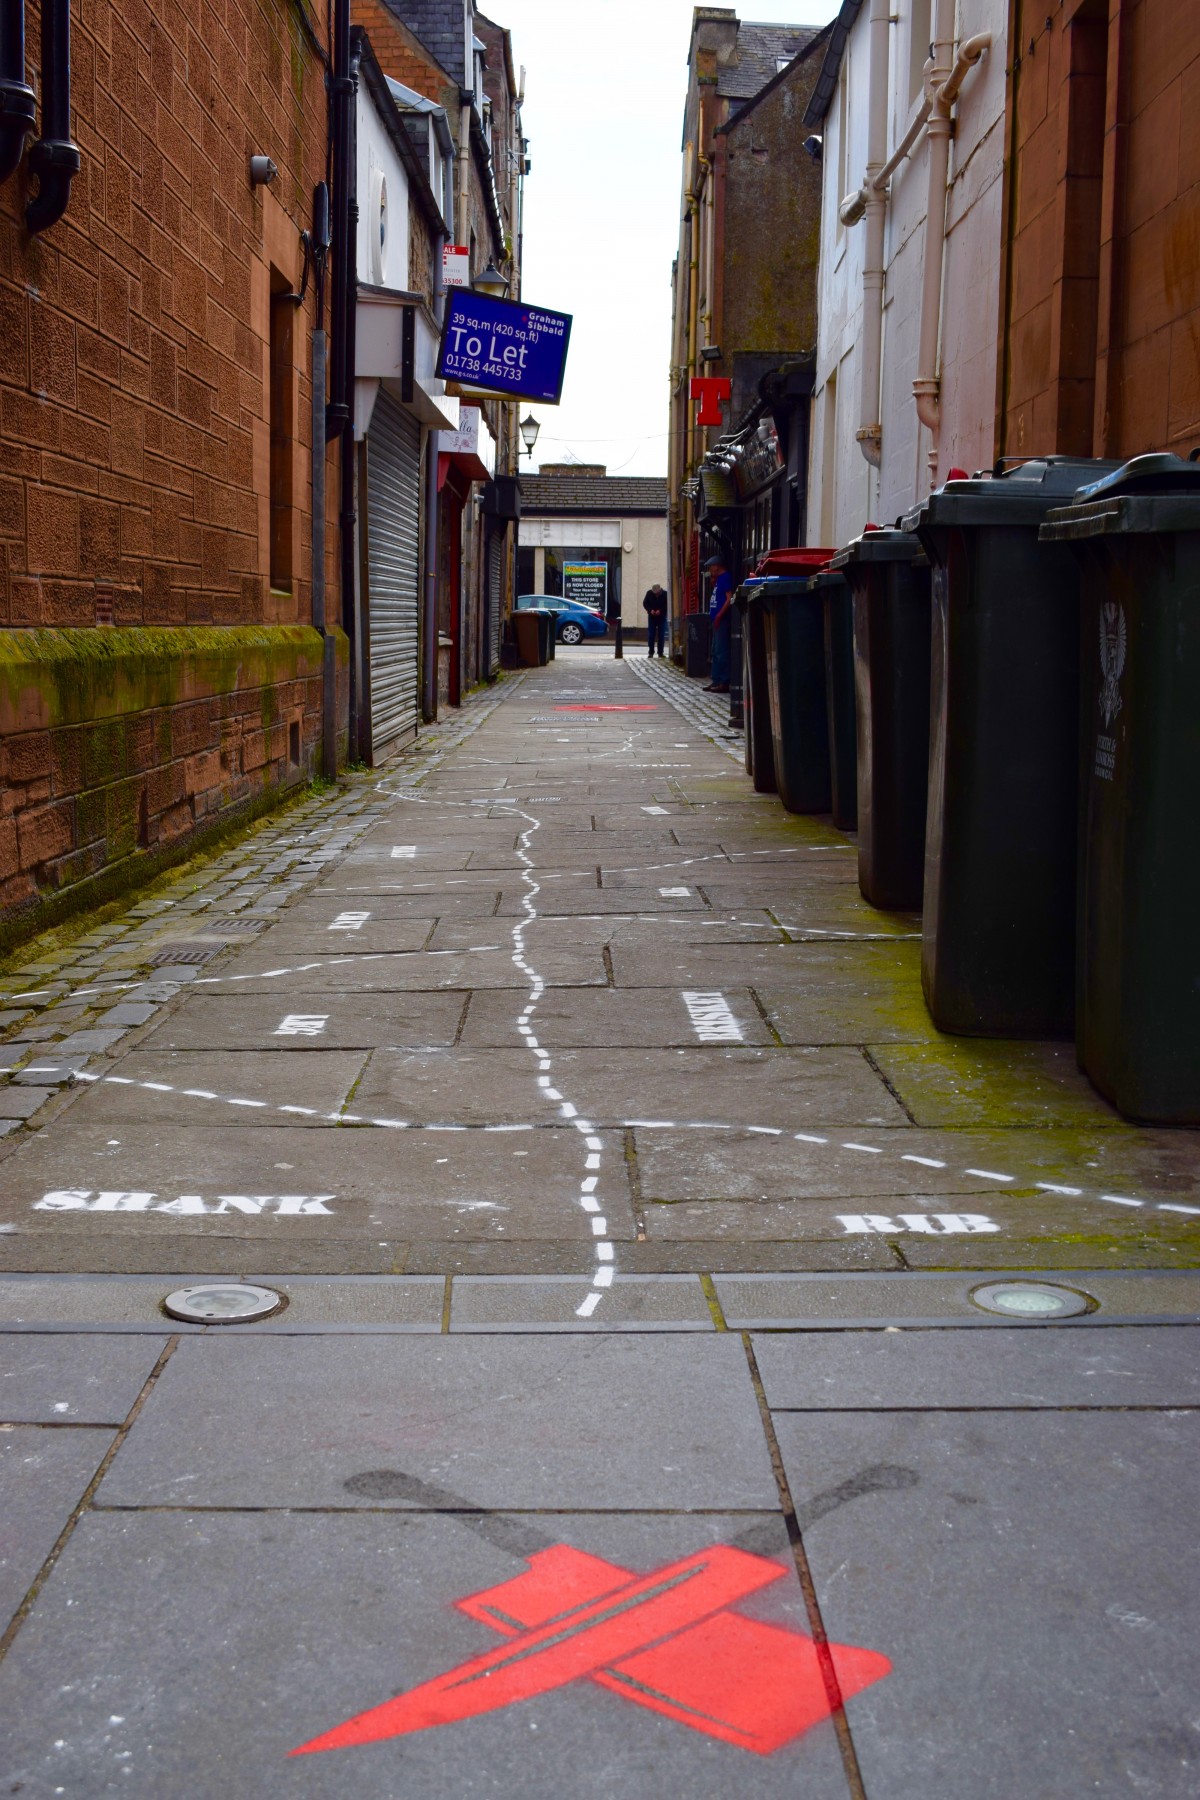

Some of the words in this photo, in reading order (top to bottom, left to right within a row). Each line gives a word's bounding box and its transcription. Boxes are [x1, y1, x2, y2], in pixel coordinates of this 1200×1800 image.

[443, 246, 456, 254] ALE
[452, 313, 465, 325] 39
[466, 317, 491, 331] sq.m
[492, 322, 513, 336] (420
[515, 329, 540, 344] sq.ft)
[528, 321, 564, 336] Sibbald
[529, 312, 565, 327] Graham
[451, 326, 482, 357] To
[489, 336, 528, 368] Let
[446, 354, 480, 371] 01738
[482, 362, 522, 380] 445733
[689, 378, 732, 426] T
[1094, 767, 1113, 781] COUNCIL
[681, 991, 744, 1041] BRISKET
[33, 1190, 337, 1216] SHANK
[834, 1212, 1002, 1235] RIB
